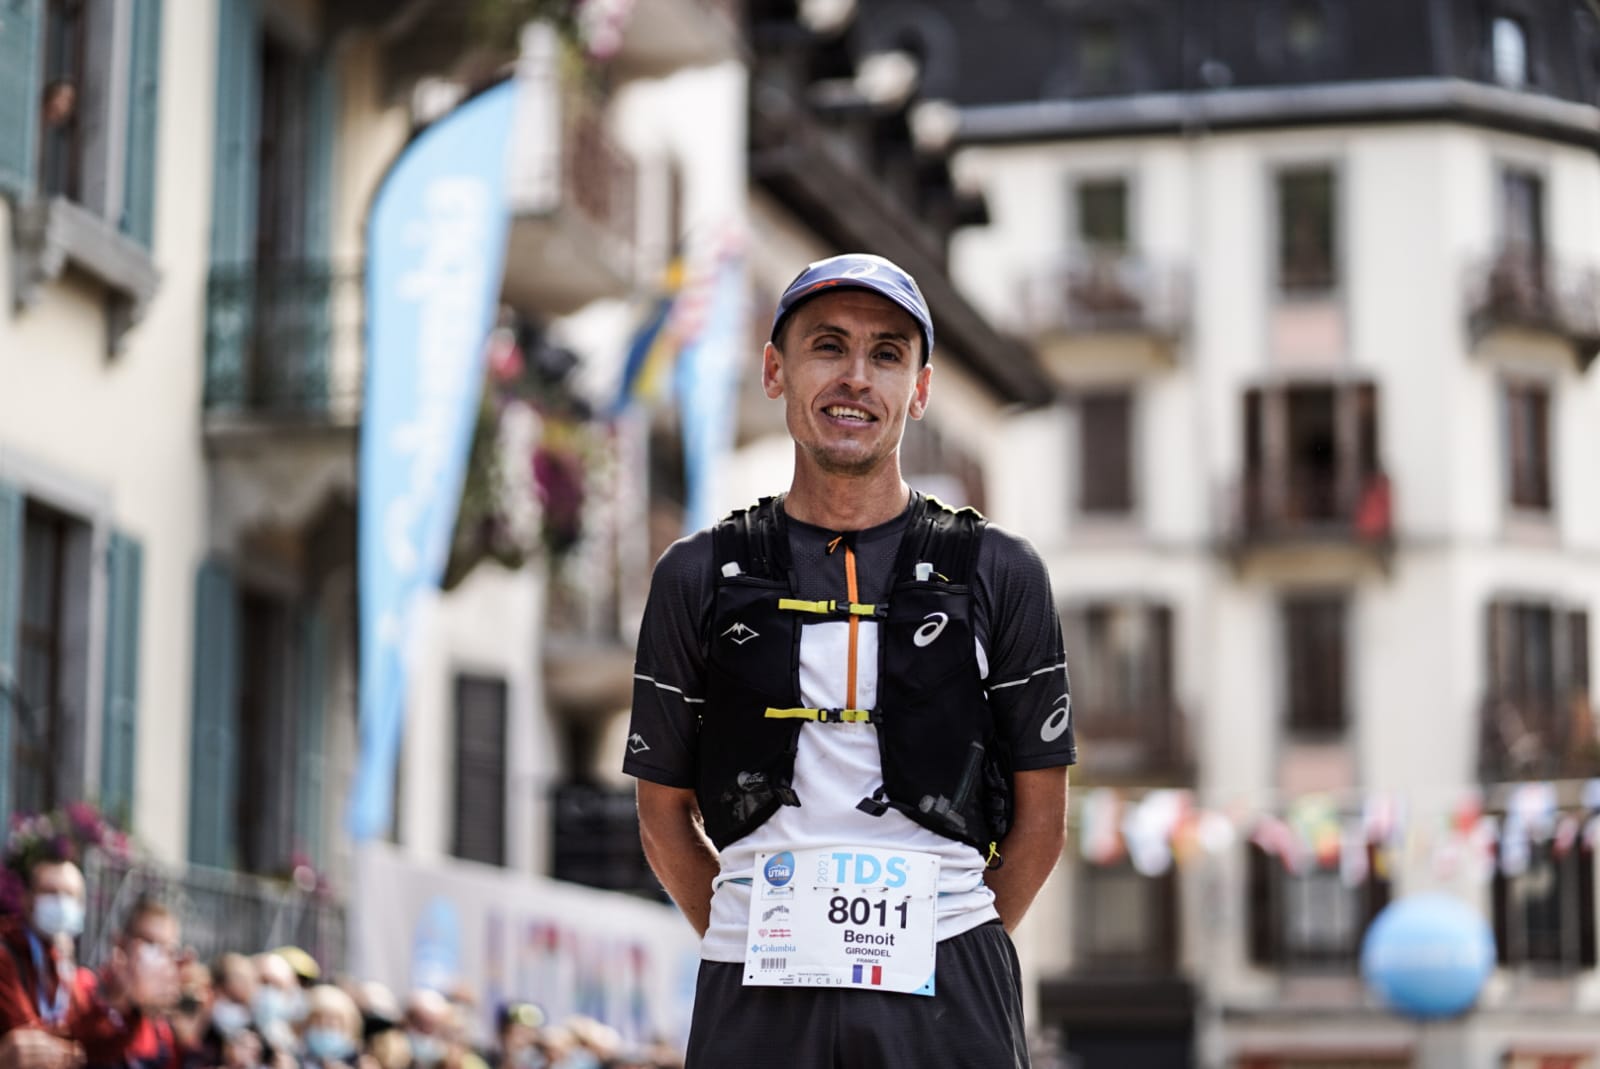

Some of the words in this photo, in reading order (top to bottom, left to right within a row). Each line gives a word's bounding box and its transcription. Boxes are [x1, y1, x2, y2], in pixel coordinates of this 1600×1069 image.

[816, 853, 829, 883] 2021
[828, 896, 908, 929] 8011
[844, 929, 895, 946] Benoit
[759, 943, 797, 953] Columbia
[845, 947, 891, 958] GIRONDEL
[856, 957, 879, 965] FRANCE
